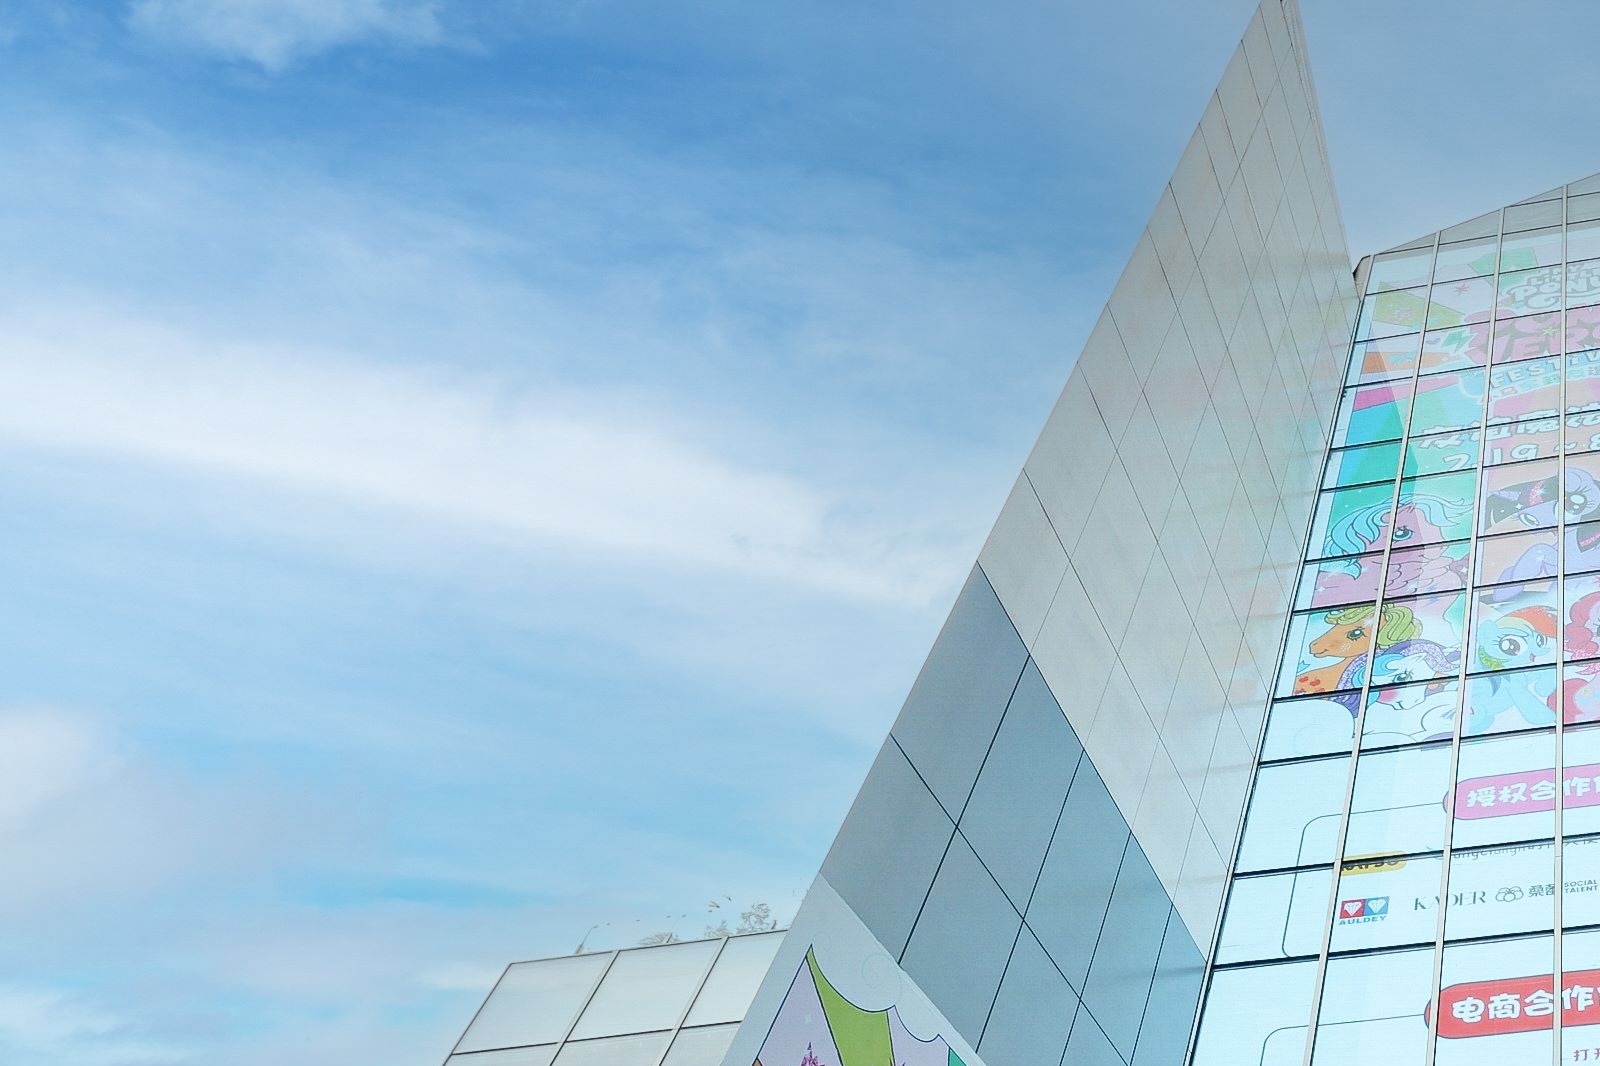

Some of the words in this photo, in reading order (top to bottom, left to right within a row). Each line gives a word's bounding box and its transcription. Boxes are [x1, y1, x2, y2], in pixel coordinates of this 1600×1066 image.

[1564, 879, 1598, 888] SOCIAL
[1564, 885, 1598, 894] TALENT
[1339, 916, 1386, 925] AULDEY
